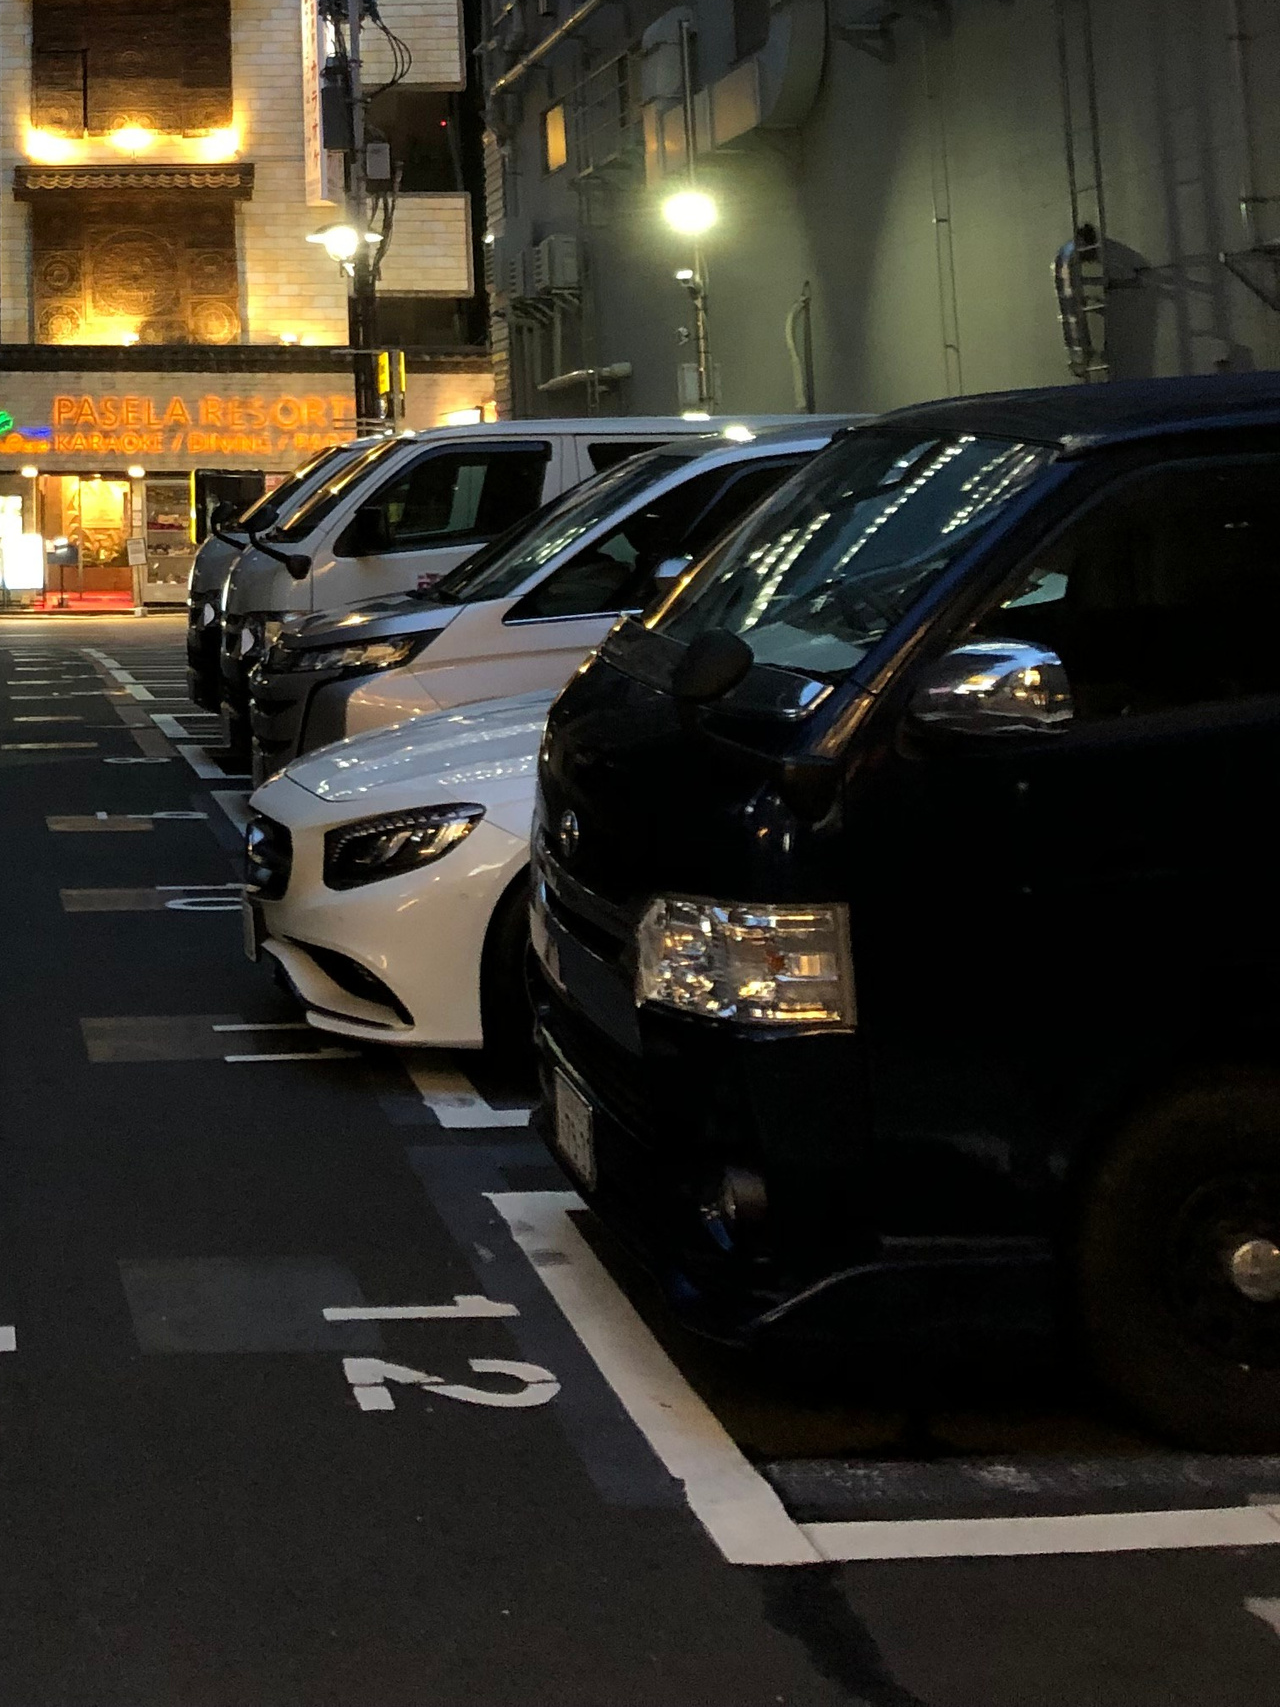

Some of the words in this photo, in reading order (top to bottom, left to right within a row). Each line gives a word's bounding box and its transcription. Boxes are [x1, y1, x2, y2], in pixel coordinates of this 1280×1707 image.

[54, 395, 191, 429] PASELA
[199, 395, 356, 430] RESORT
[54, 432, 164, 453] KARAOKE
[187, 432, 269, 454] DINING
[293, 432, 356, 452] PART
[322, 1294, 562, 1413] 12
